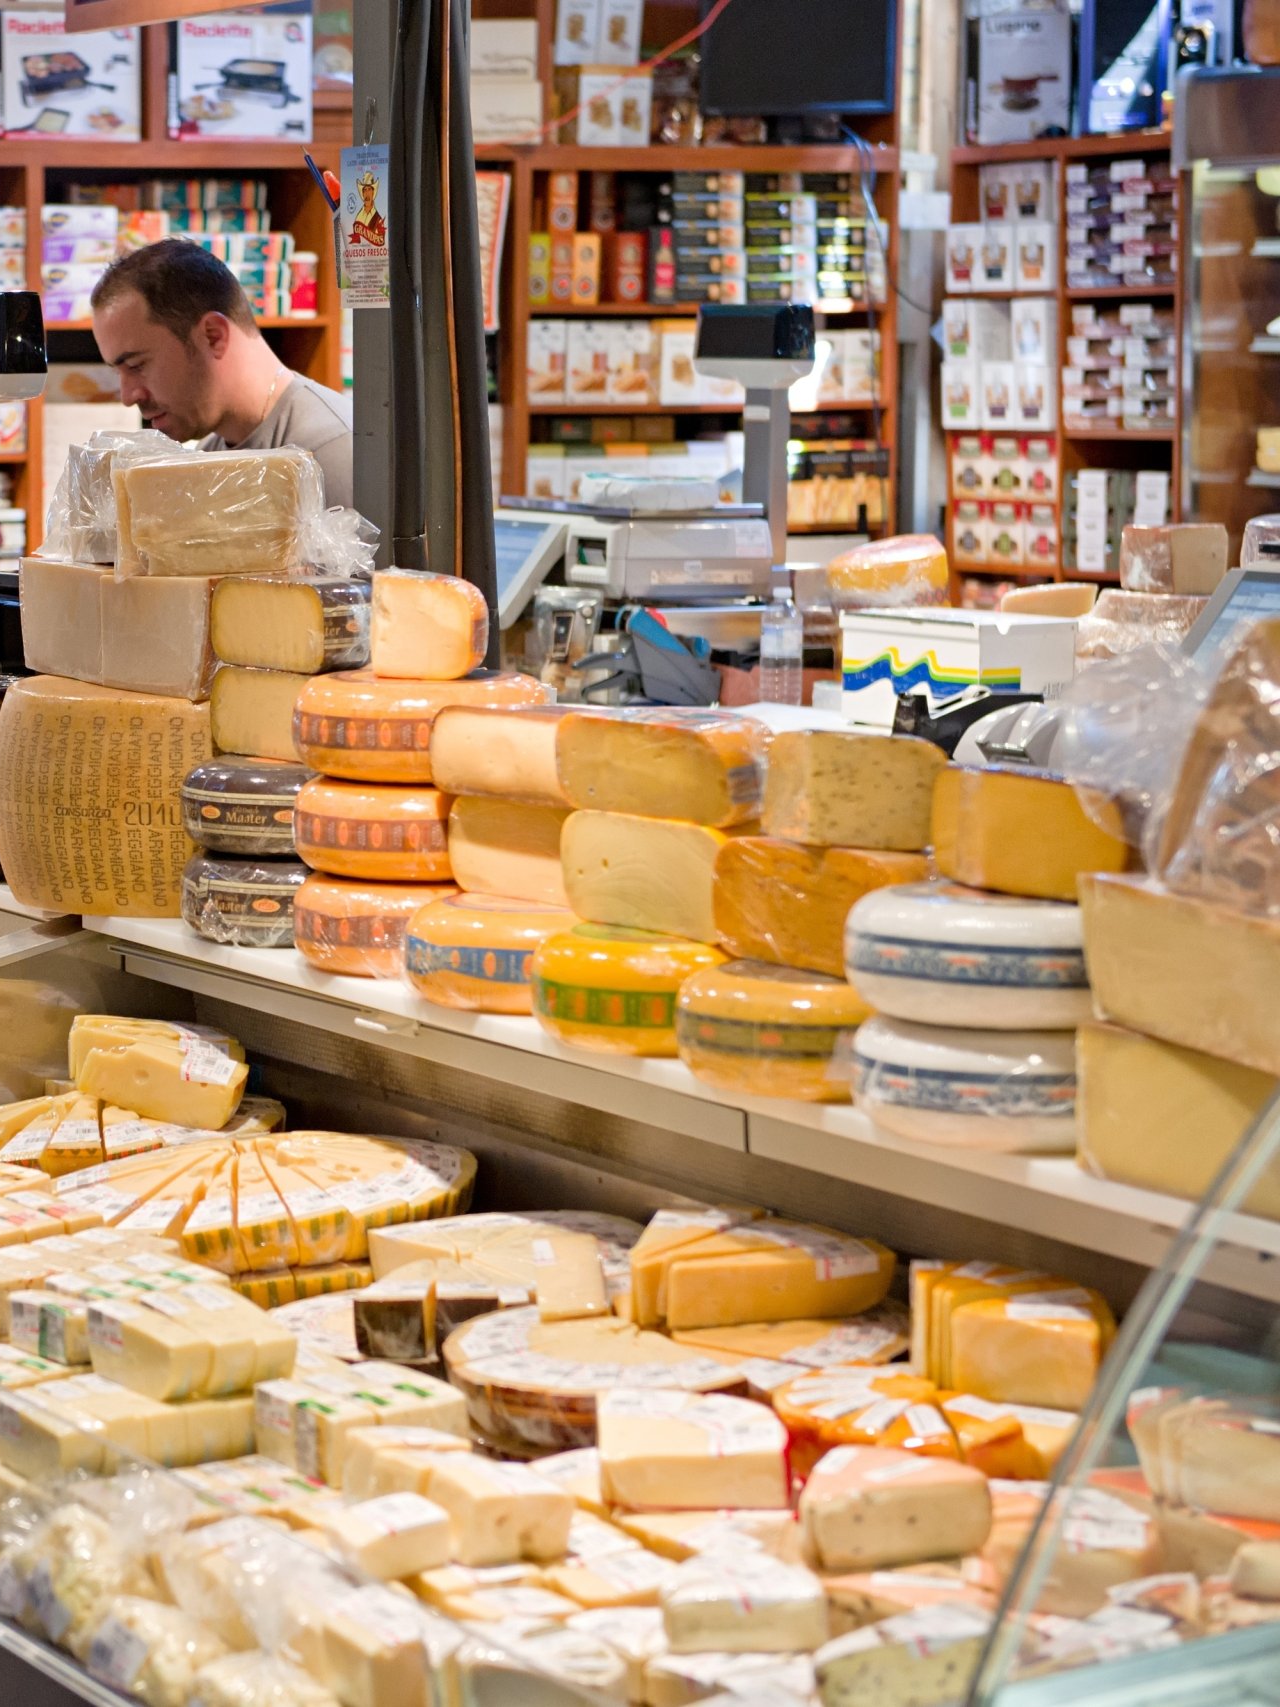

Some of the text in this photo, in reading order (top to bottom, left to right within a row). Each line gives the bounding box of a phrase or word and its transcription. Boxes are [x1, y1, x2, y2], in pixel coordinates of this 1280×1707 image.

[184, 23, 253, 38] Raclette
[345, 248, 365, 258] QUESOS
[225, 811, 268, 824] Master
[215, 898, 246, 913] aster
